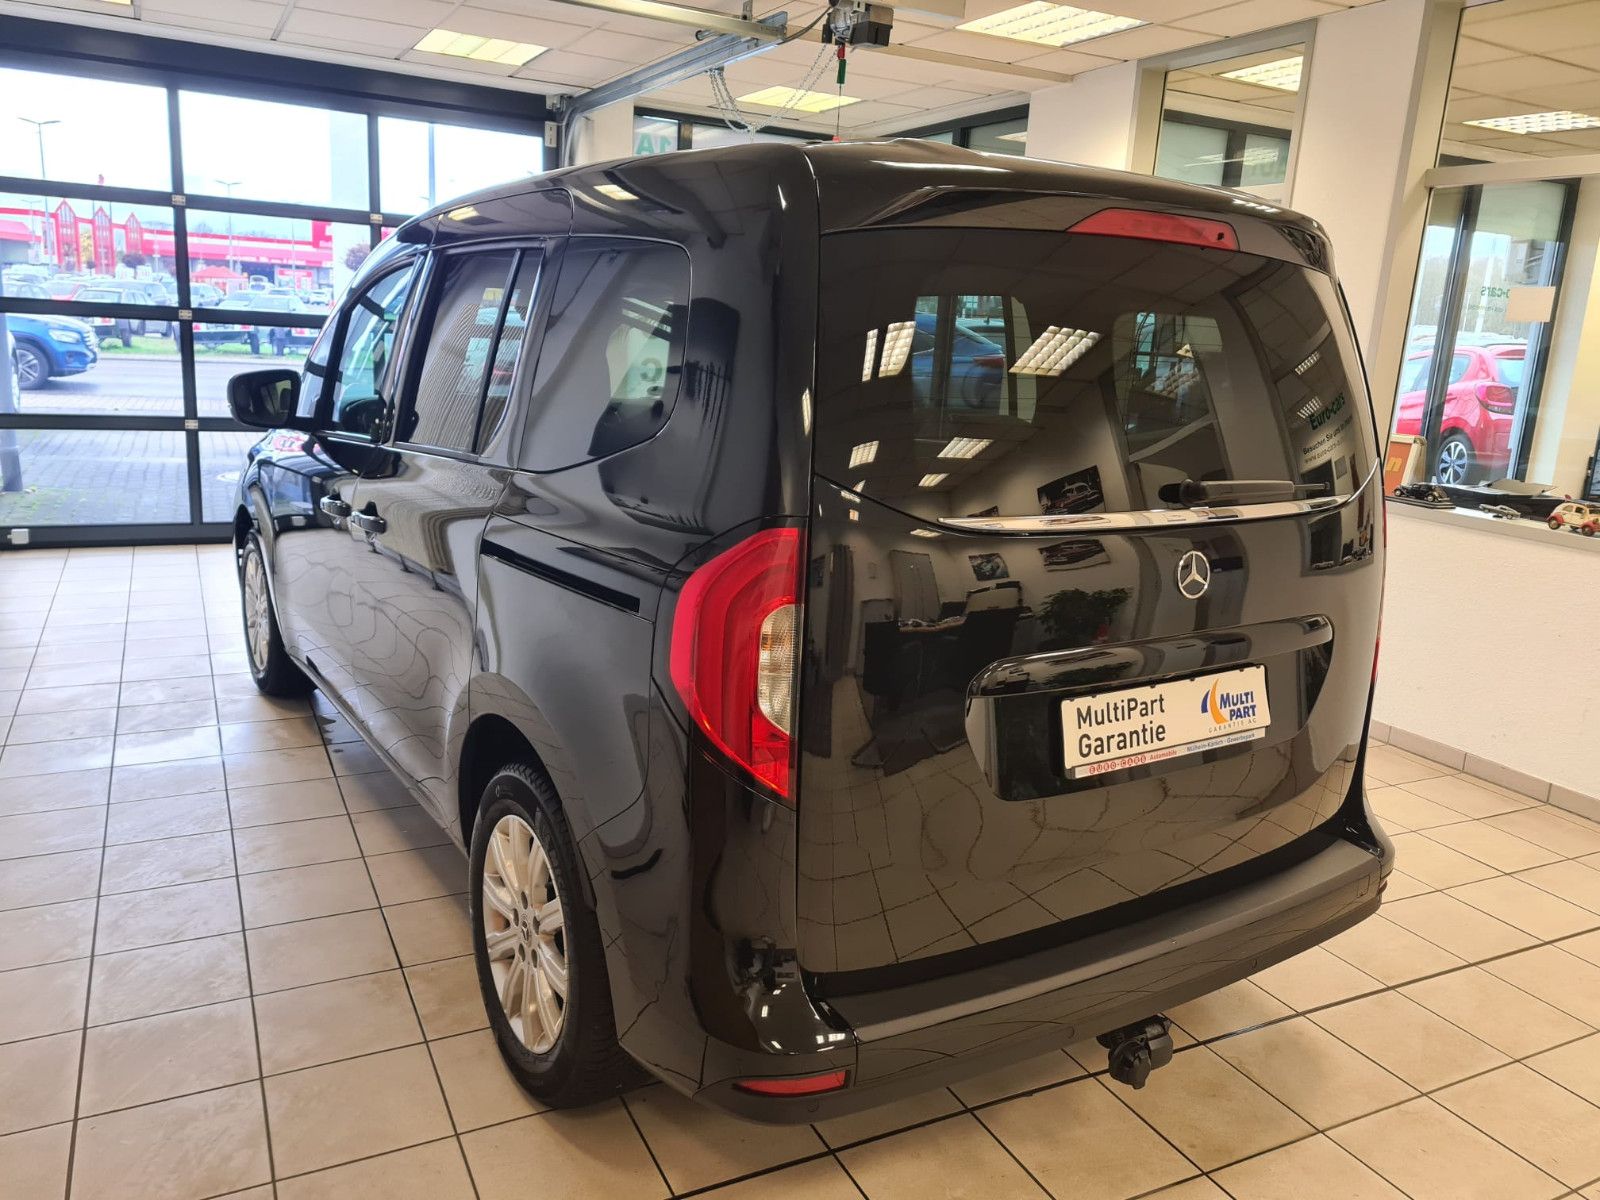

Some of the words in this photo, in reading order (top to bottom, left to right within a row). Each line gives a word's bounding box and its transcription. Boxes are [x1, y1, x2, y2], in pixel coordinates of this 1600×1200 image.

[1076, 693, 1165, 730] MultiPart
[1219, 690, 1254, 710] MULTI
[1229, 704, 1257, 722] PART
[1078, 720, 1166, 759] Garantie
